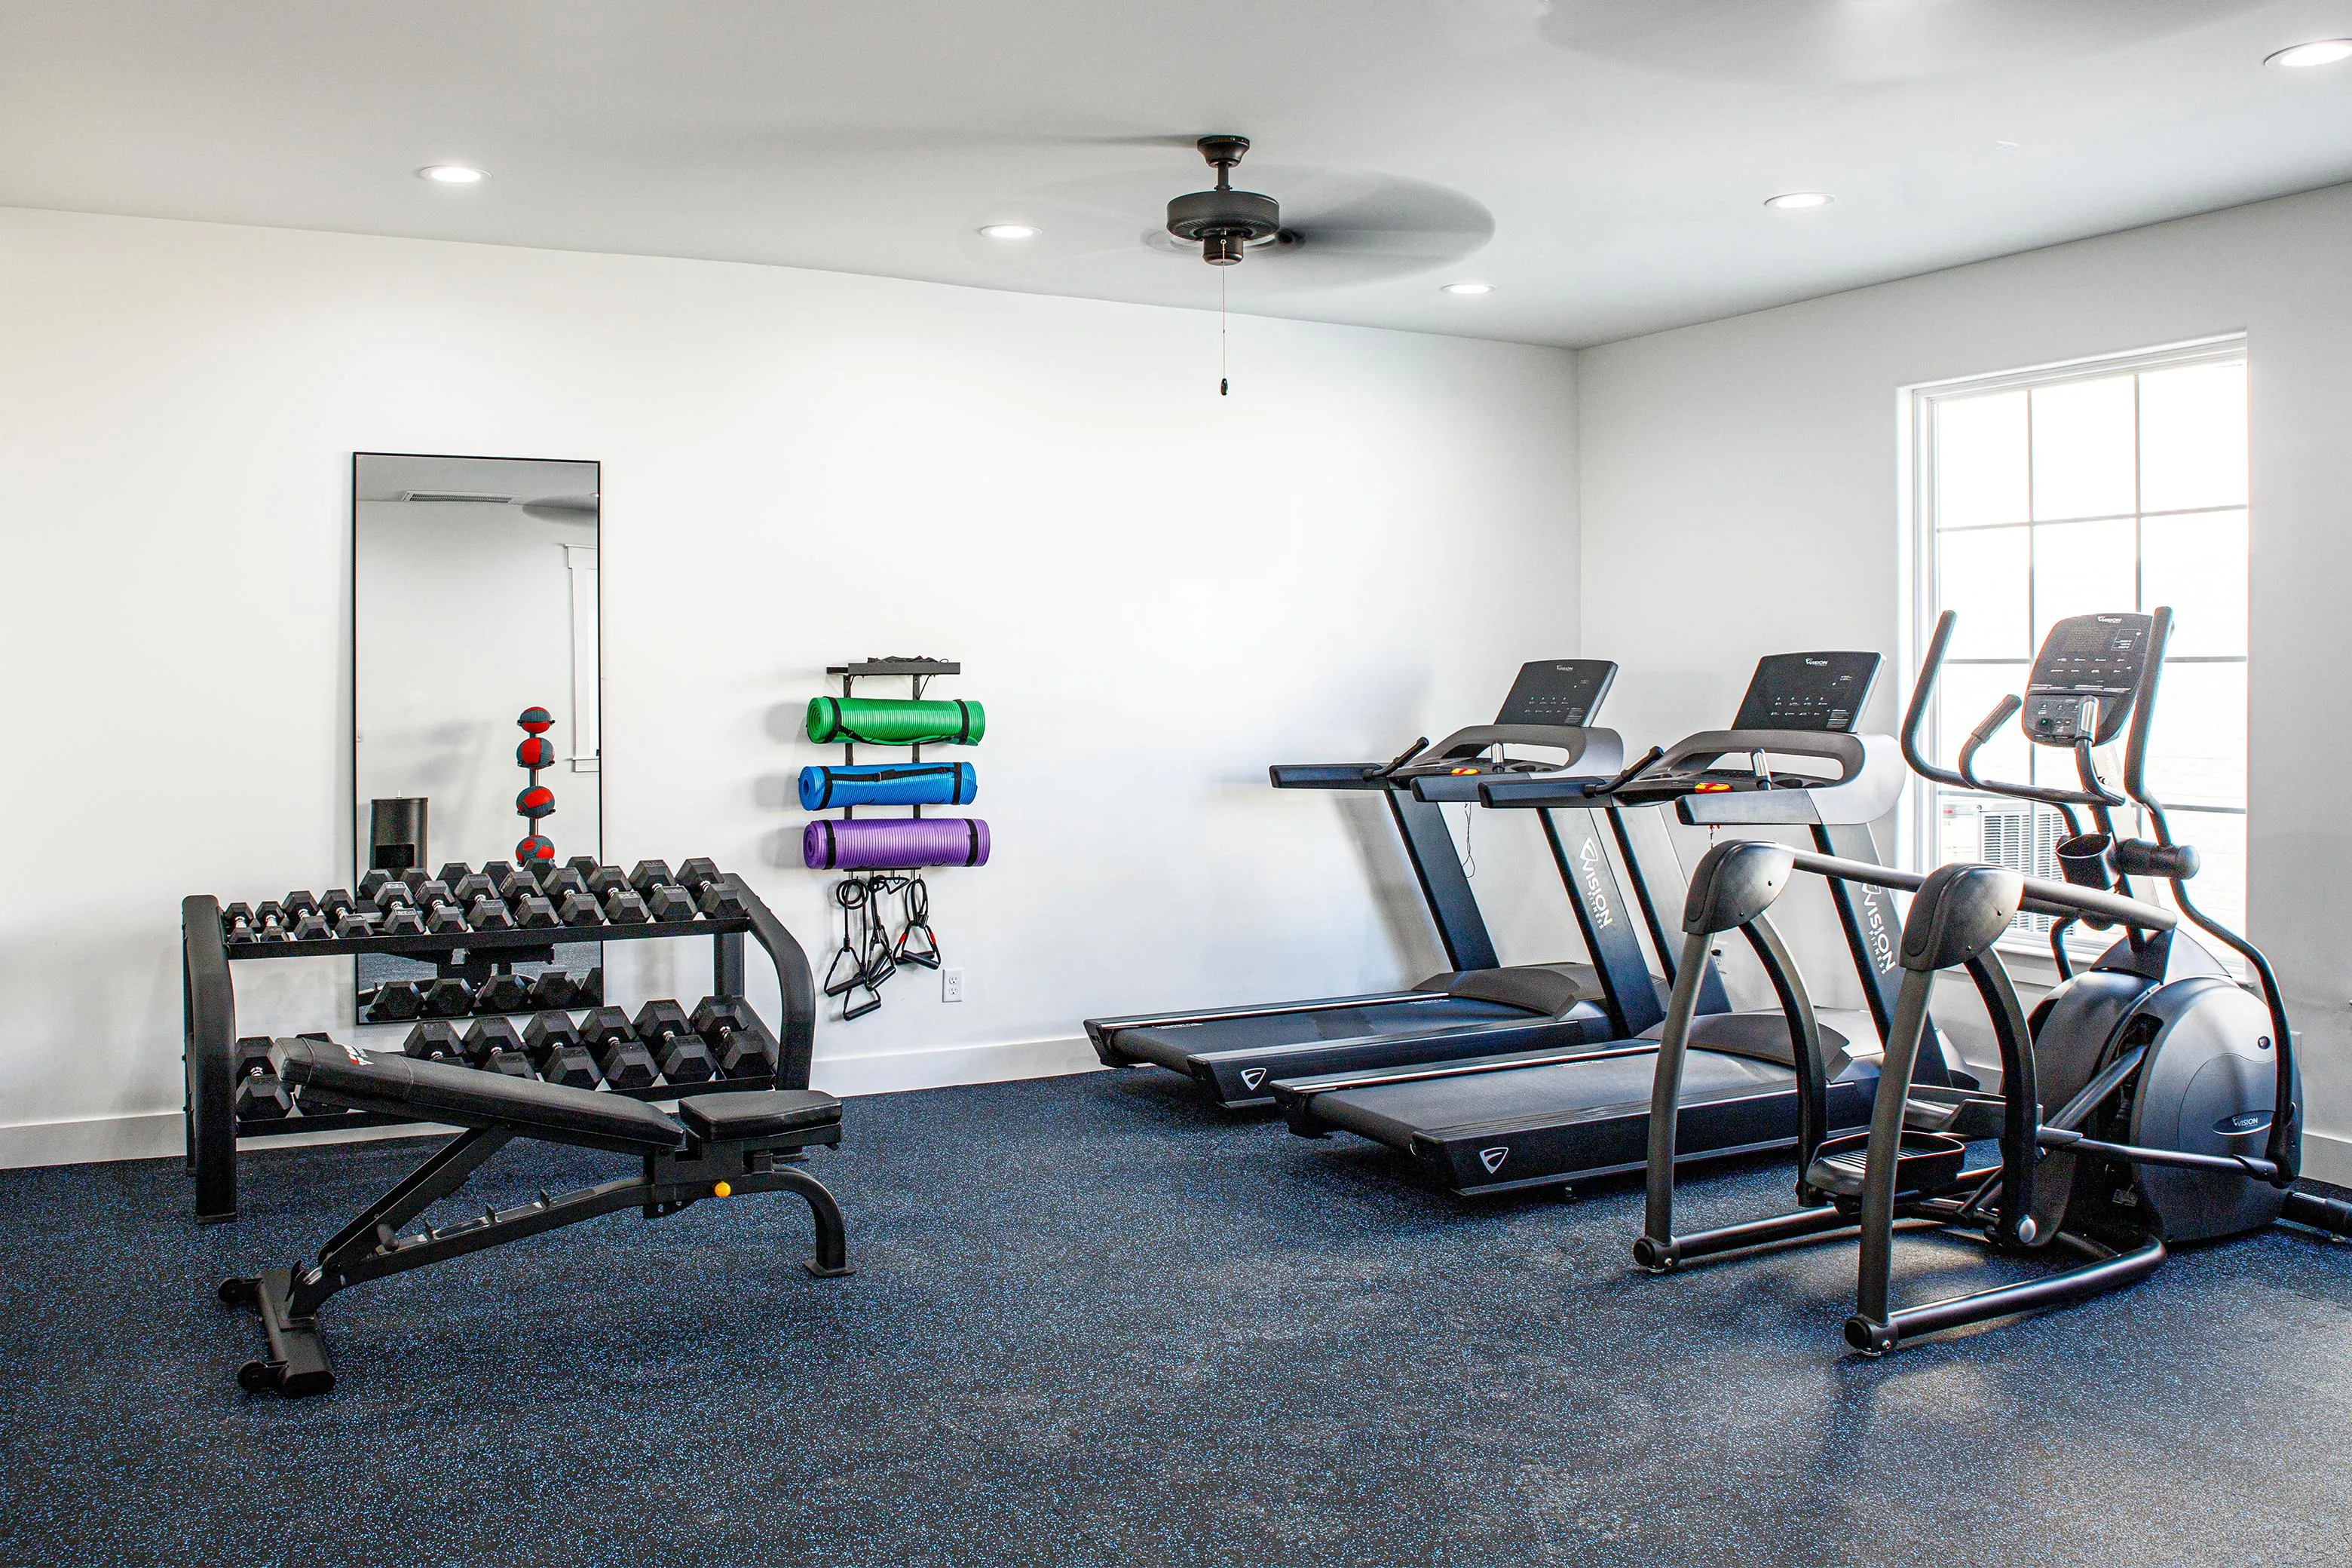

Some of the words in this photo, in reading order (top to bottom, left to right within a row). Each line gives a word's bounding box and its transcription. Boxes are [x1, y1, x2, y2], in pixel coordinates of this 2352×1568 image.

[1582, 859, 1613, 926] VISION
[1864, 894, 1896, 972] VISION
[1868, 930, 1887, 975] FITNESS
[2237, 1118, 2259, 1126] VISION
